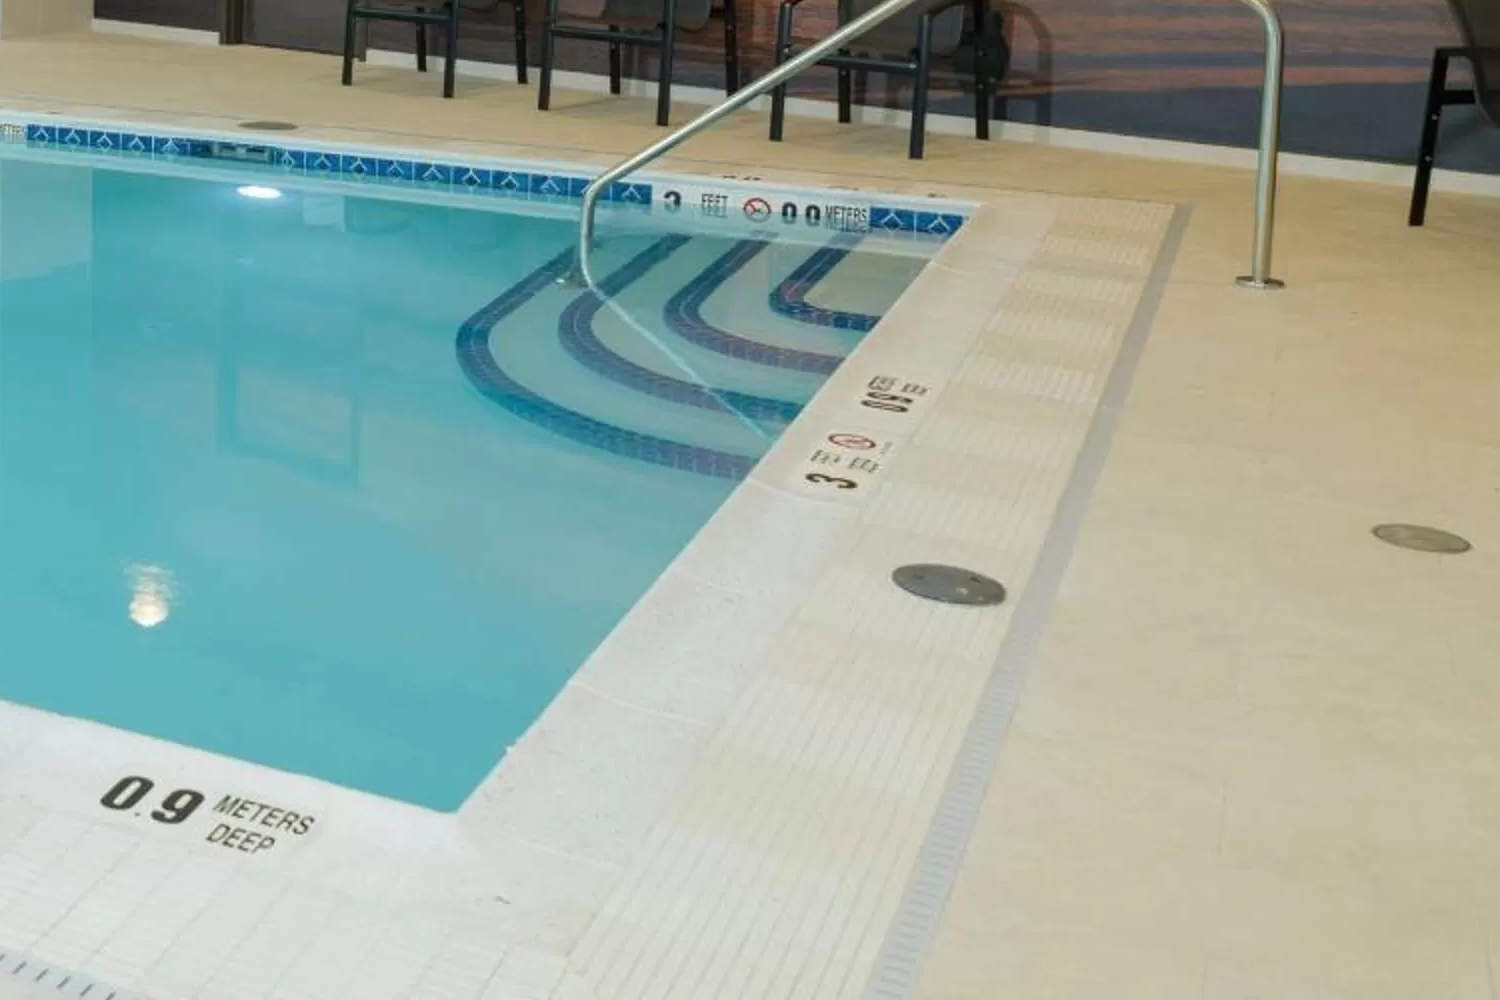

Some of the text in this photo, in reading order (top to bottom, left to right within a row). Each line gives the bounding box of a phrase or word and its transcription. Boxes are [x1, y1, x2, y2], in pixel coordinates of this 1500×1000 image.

[805, 473, 858, 489] 3
[212, 794, 315, 836] METERS
[205, 823, 276, 854] DEEP
